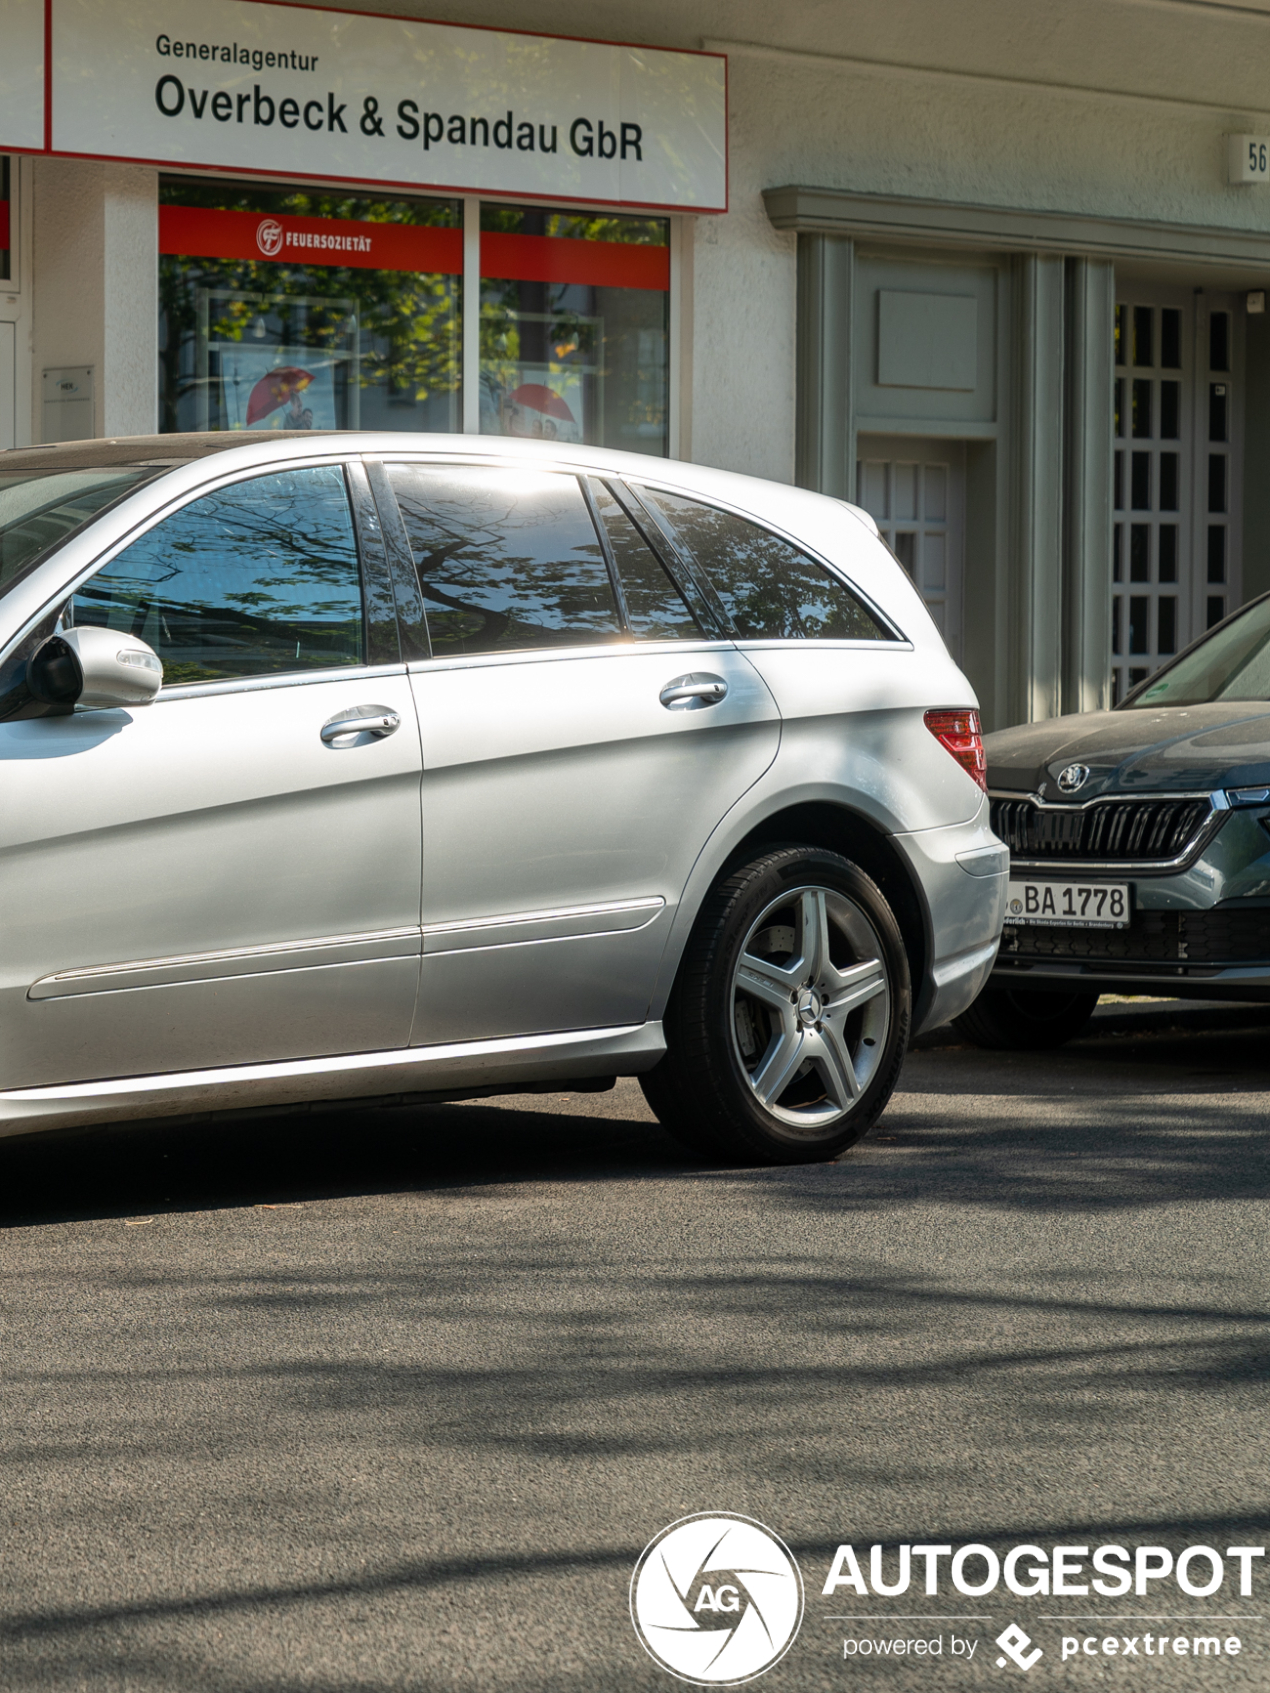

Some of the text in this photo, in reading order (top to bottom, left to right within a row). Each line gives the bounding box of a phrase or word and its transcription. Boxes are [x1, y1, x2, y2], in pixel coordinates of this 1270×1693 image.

[155, 34, 319, 73] Generalagentur
[154, 74, 644, 162] Overbeck & Spandau GbR
[1249, 142, 1267, 172] 56
[286, 232, 372, 252] FEUERSOZIETÄT
[1024, 885, 1056, 915] BA
[1062, 887, 1125, 917] 1778
[1004, 917, 1026, 925] derlich
